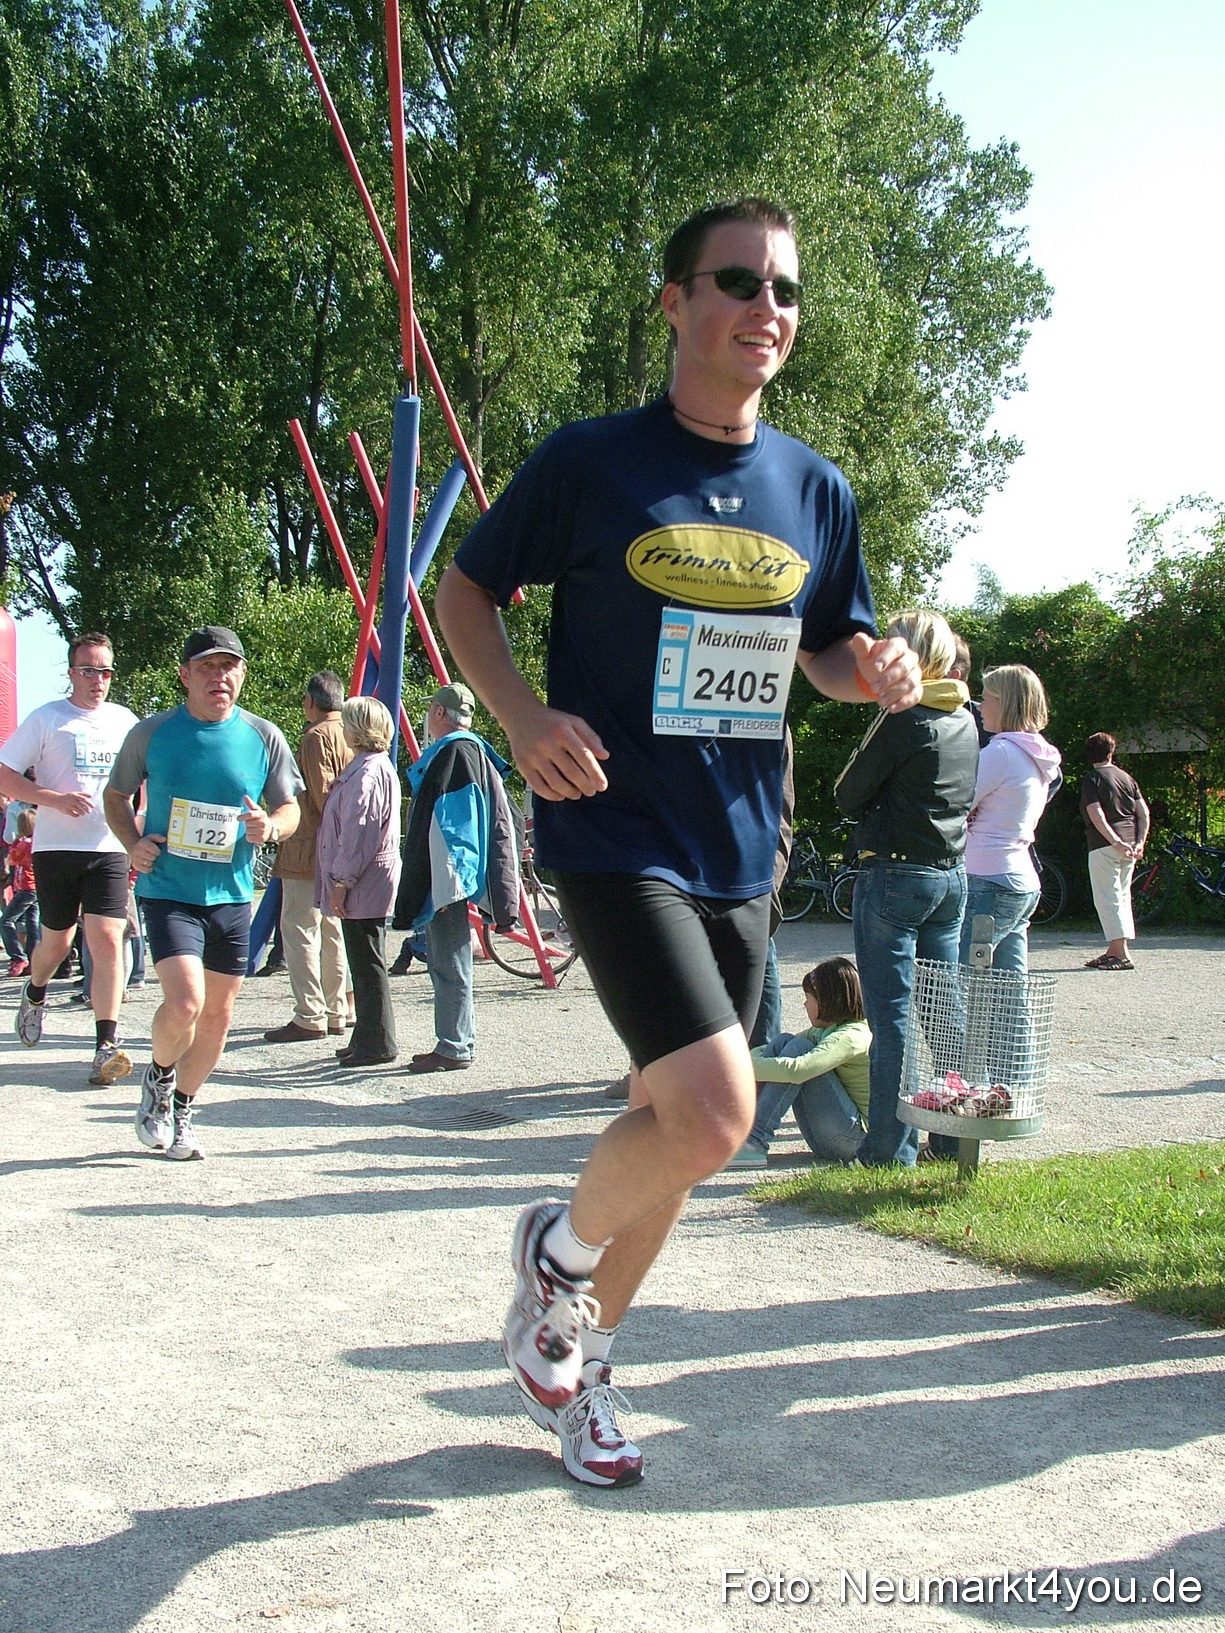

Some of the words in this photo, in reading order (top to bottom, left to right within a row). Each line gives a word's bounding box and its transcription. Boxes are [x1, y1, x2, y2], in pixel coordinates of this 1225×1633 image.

[639, 546, 732, 572] trimm
[748, 554, 806, 578] fit
[665, 573, 709, 585] wellness
[716, 577, 748, 589] fitness
[749, 581, 778, 592] studio
[697, 624, 788, 652] Maximilian
[662, 657, 671, 675] C
[693, 668, 779, 704] 2405
[654, 715, 703, 730] BOCK
[733, 719, 780, 731] PFLEIDERER
[190, 806, 233, 824] Christoph
[172, 820, 178, 829] C
[195, 828, 227, 847] 122
